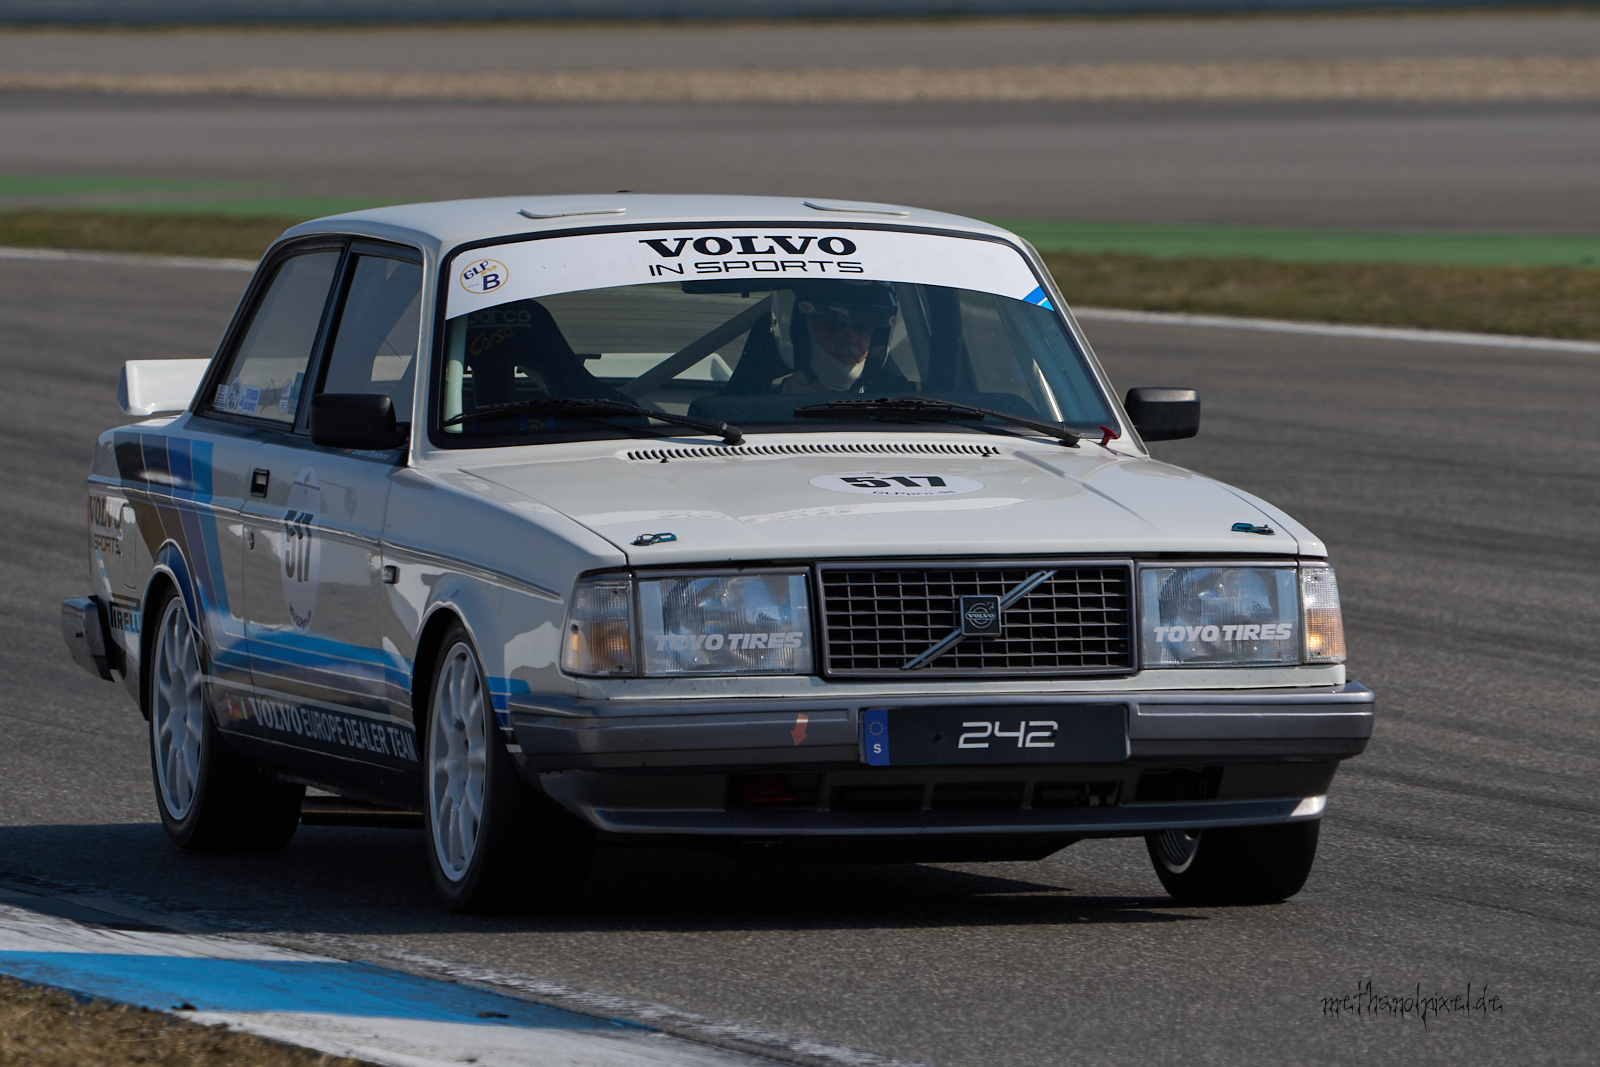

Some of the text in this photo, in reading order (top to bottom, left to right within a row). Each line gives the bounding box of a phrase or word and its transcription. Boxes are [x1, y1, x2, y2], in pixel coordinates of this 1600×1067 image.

[639, 236, 857, 257] VOLVO
[463, 260, 489, 280] GLP
[649, 260, 864, 276] IN SPORTS
[483, 273, 501, 291] B
[467, 309, 532, 329] parco
[469, 325, 516, 355] Corsa
[840, 476, 947, 488] 517
[89, 496, 121, 529] VOLVO
[94, 534, 121, 554] SPORTS
[284, 510, 314, 583] 517
[654, 632, 803, 652] TOYO TIRES
[1153, 623, 1293, 643] TOYO TIRES
[248, 697, 419, 762] VOLVO EUROPE DEALER TEAM
[958, 720, 1059, 749] 242
[873, 743, 882, 754] S
